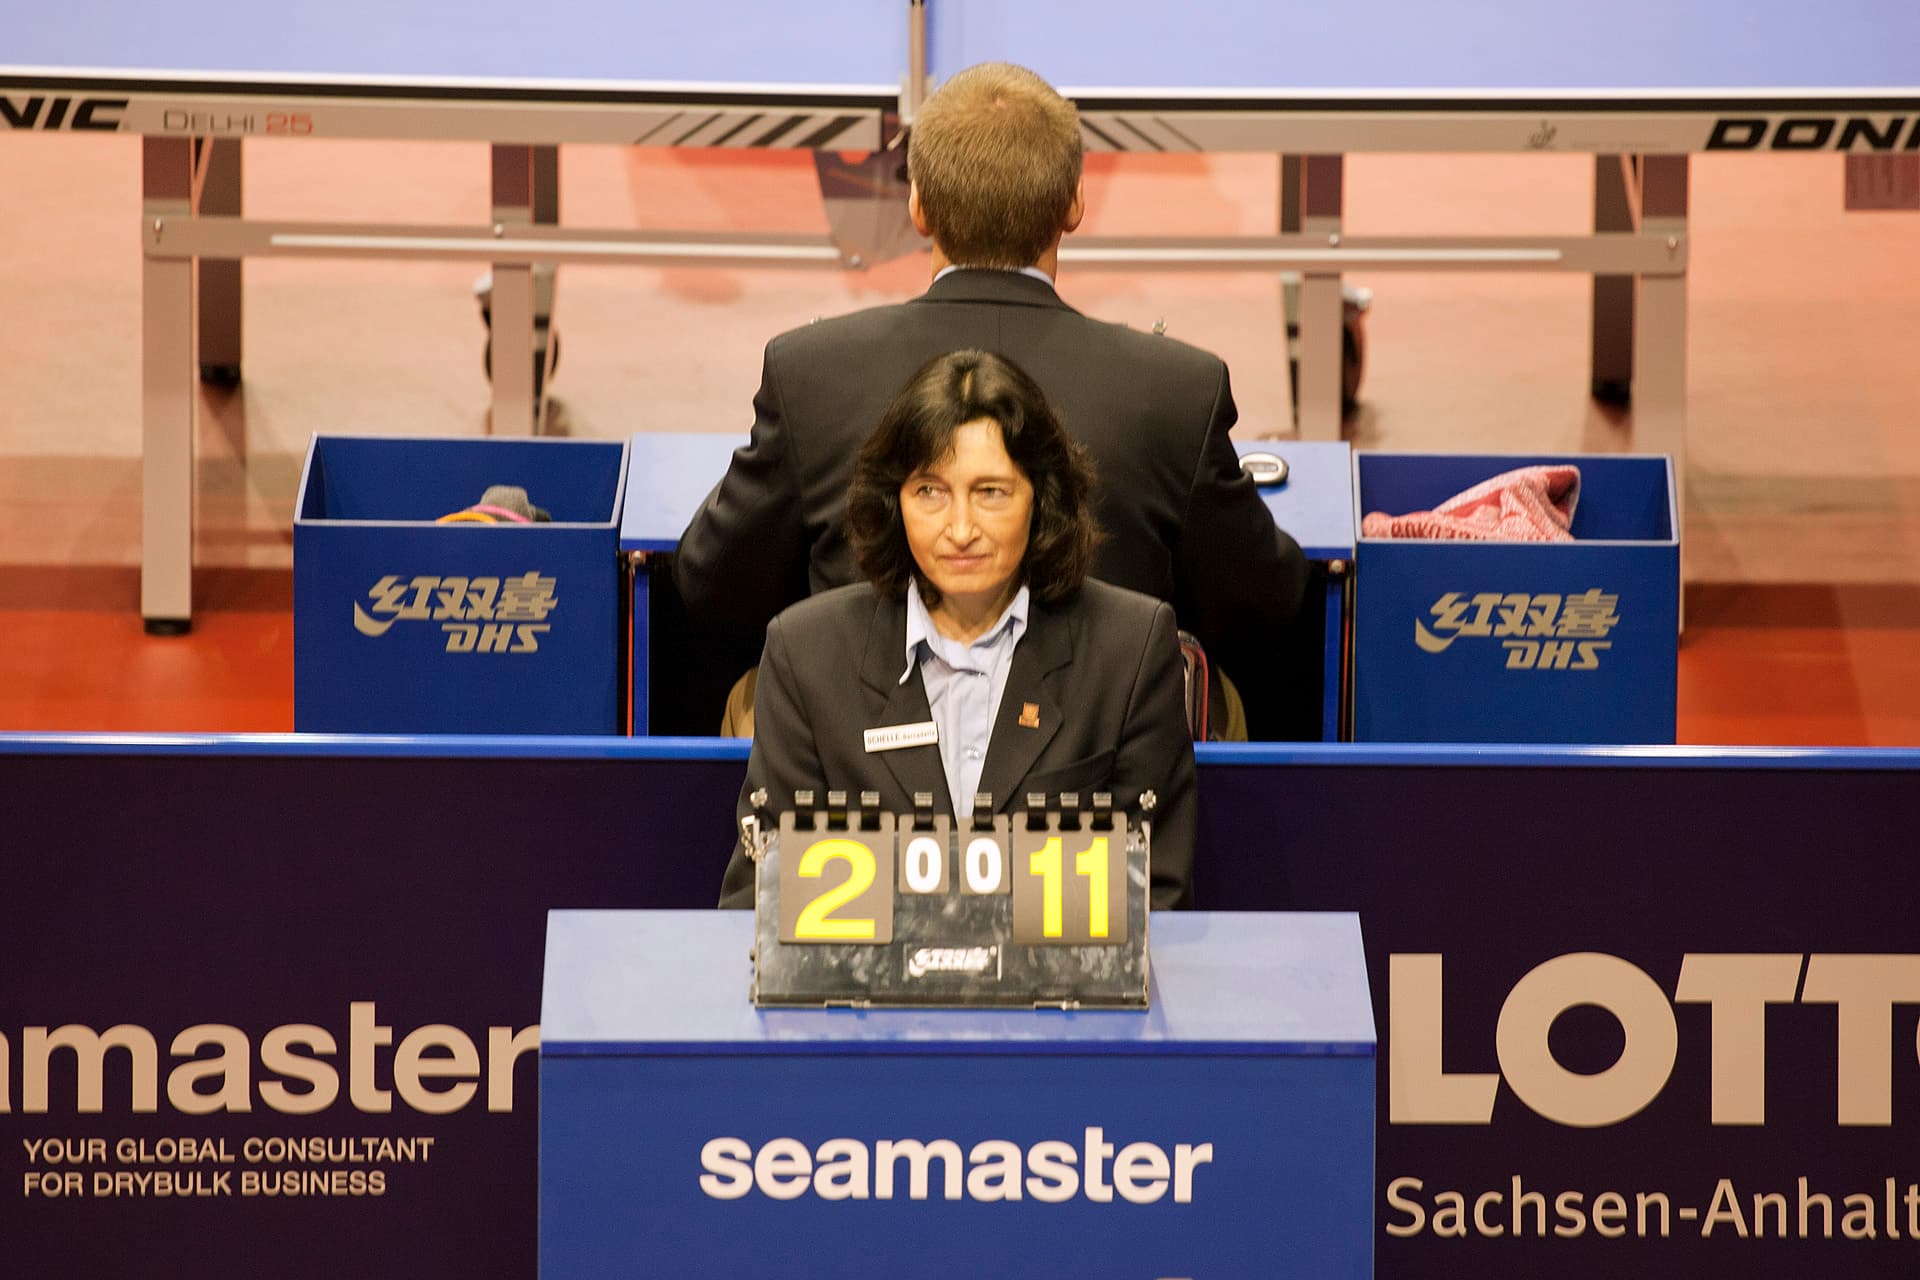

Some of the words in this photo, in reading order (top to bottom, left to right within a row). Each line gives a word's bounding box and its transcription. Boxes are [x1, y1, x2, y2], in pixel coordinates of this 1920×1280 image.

[164, 109, 254, 132] DELHI
[265, 111, 313, 135] 25
[441, 623, 551, 653] DHS
[1502, 640, 1612, 670] DHS
[798, 837, 877, 939] 2
[905, 837, 943, 893] 0
[965, 837, 1002, 893] 0
[1029, 836, 1110, 938] 11
[0, 1001, 540, 1114] master
[1389, 951, 1920, 1127] LOTT
[23, 1137, 107, 1163] YOUR
[116, 1137, 236, 1163] GLOBAL
[243, 1136, 435, 1163] CONSULTANT
[699, 1126, 1213, 1203] seamaster
[24, 1171, 84, 1197] FOR
[93, 1171, 232, 1197] DRYBULK
[241, 1170, 386, 1196] BUSINESS
[1386, 1174, 1920, 1240] Sachsen-Anhalt
